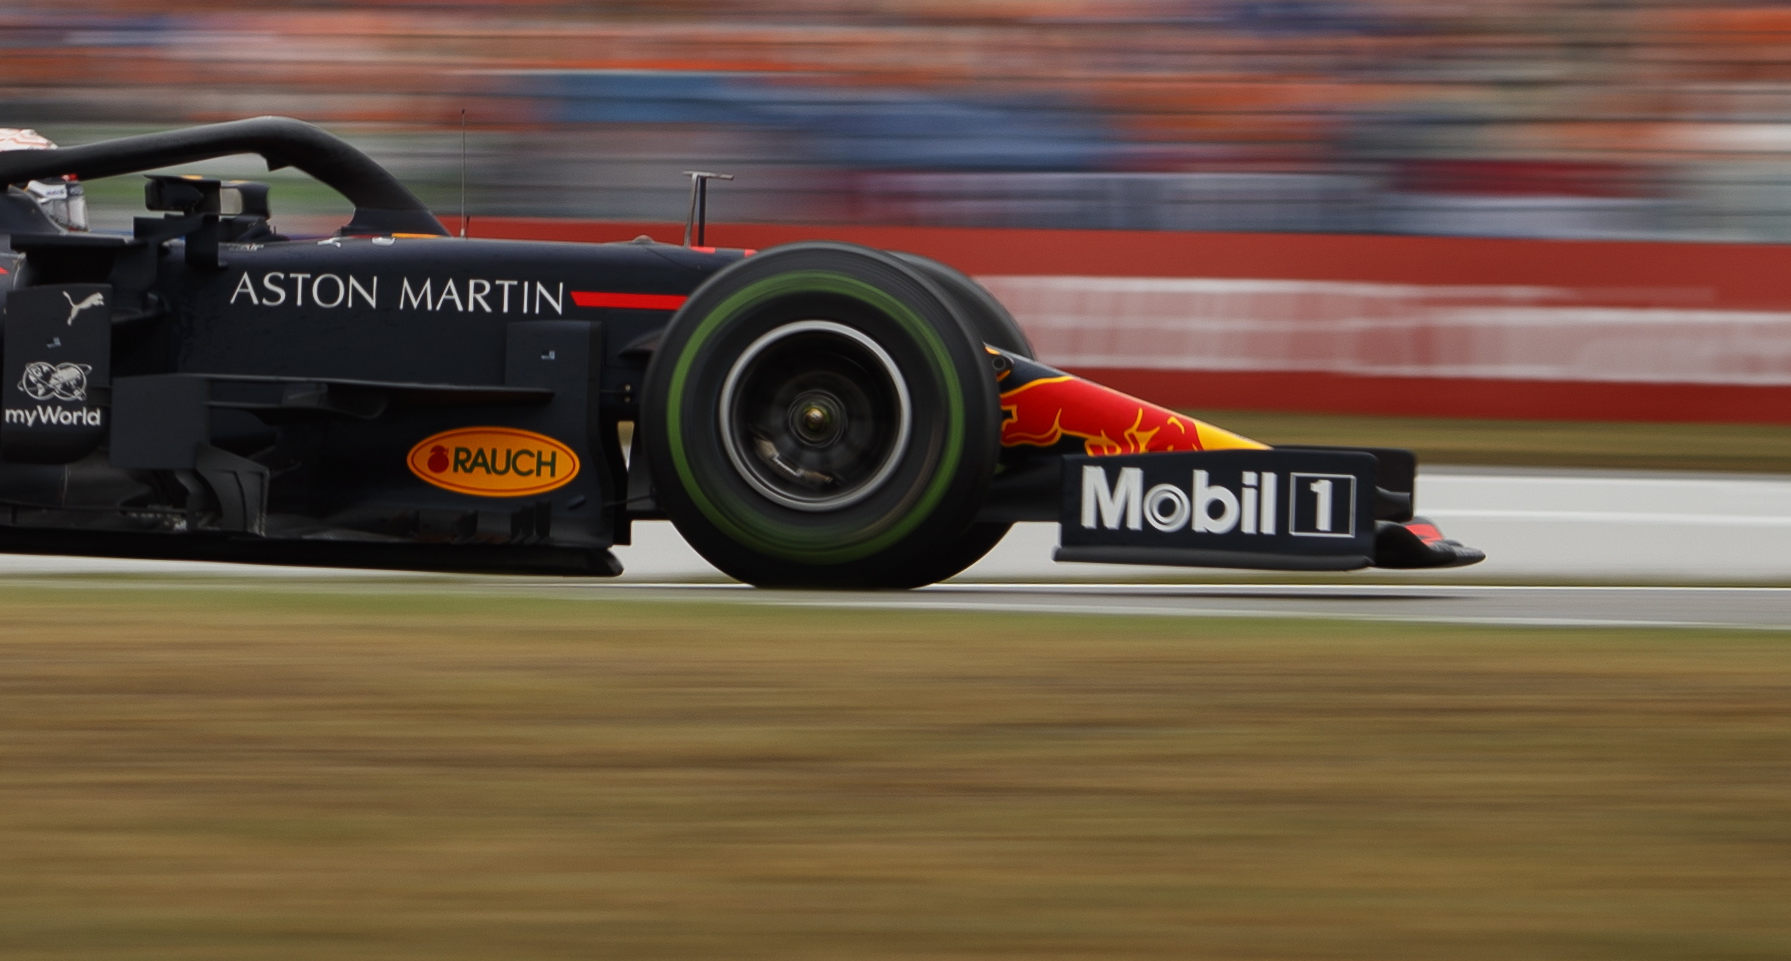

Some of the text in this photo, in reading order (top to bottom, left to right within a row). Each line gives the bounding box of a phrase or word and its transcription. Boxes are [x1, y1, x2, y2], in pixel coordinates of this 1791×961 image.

[230, 271, 564, 316] ASTON MARTIN
[5, 405, 101, 427] myWorld
[452, 446, 557, 477] RAUCH
[1080, 465, 1334, 534] Mobil 1
